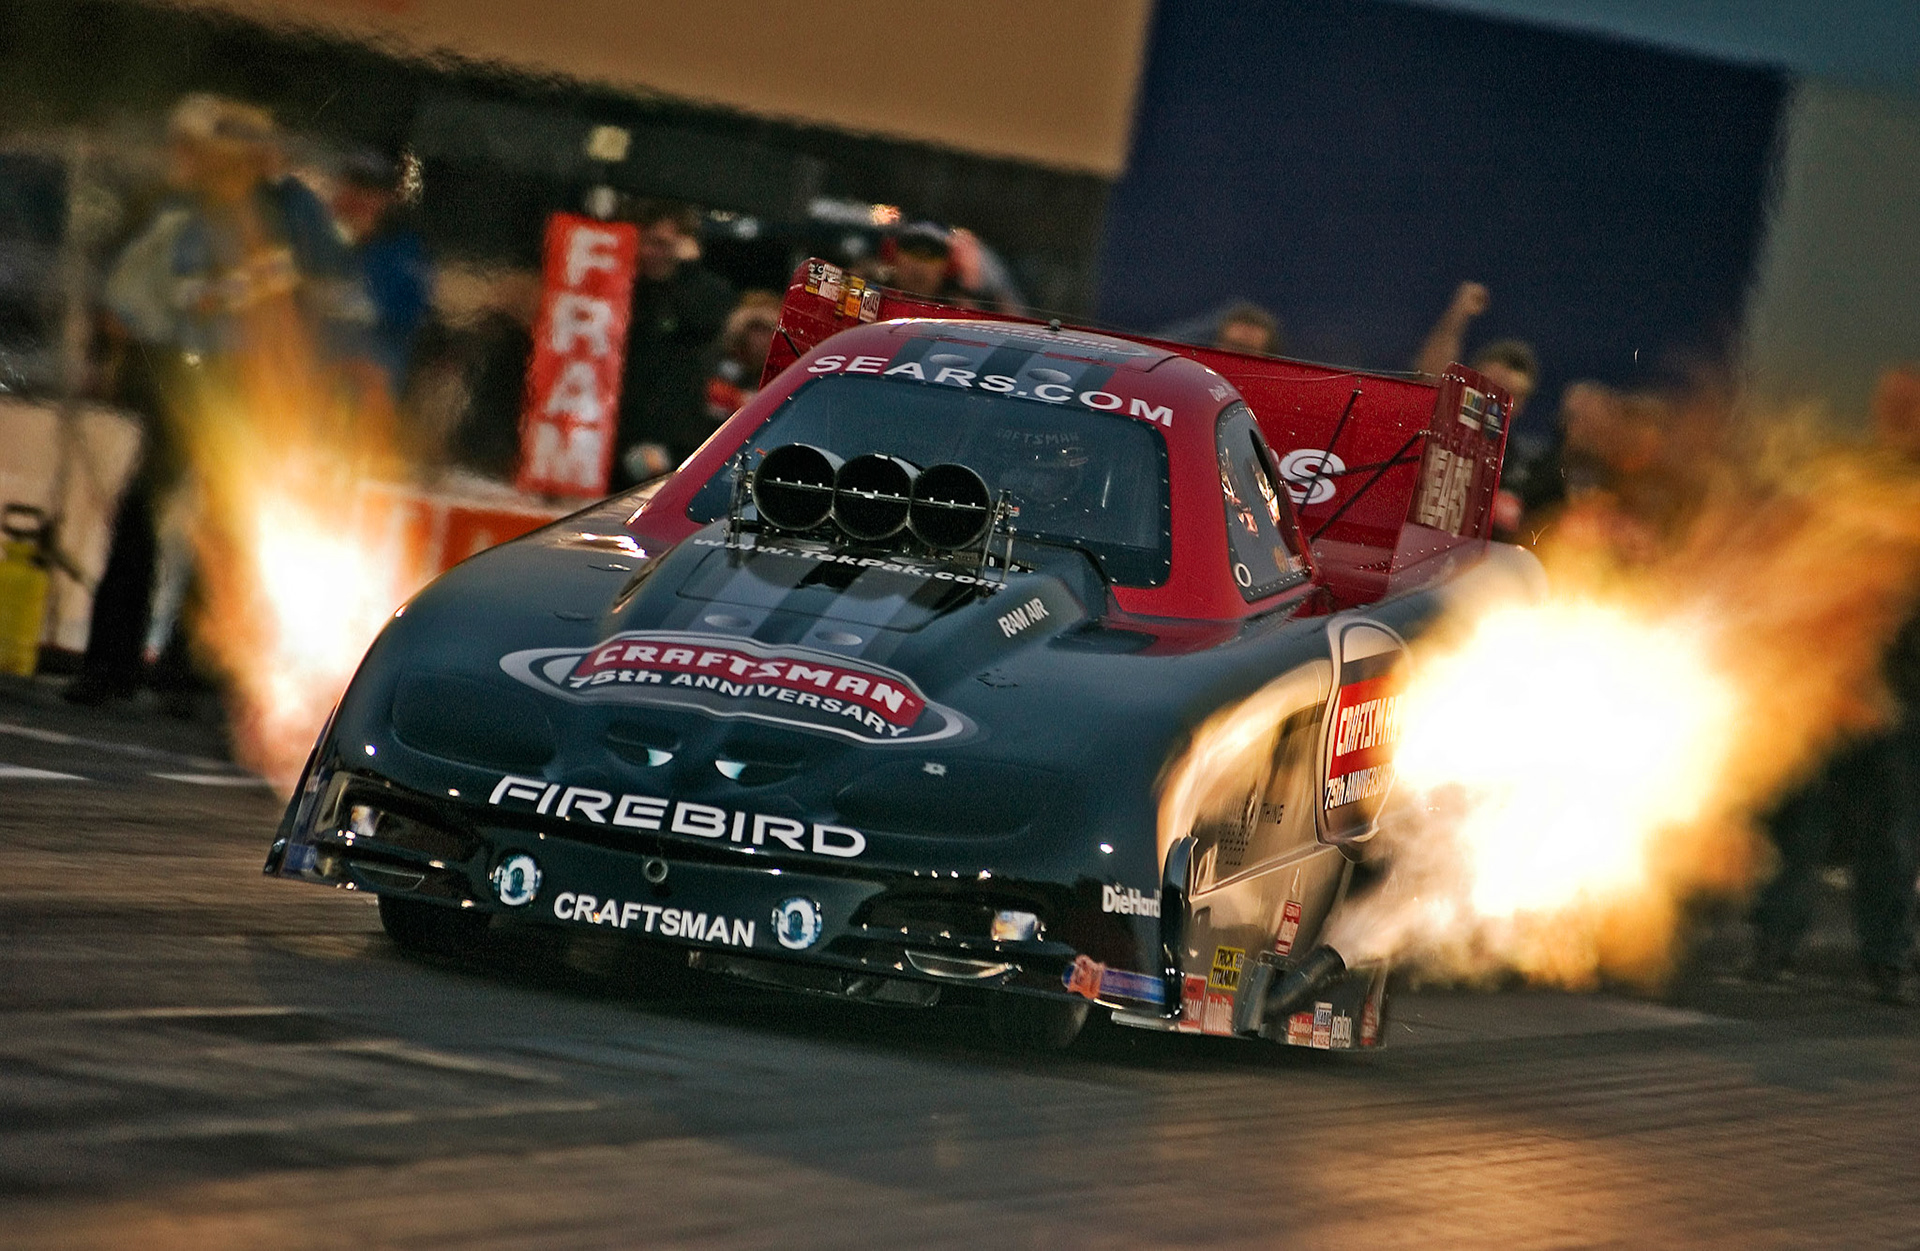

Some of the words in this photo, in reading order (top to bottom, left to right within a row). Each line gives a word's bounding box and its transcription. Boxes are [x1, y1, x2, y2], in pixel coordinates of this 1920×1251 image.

[528, 226, 618, 488] FRAM
[807, 354, 1174, 428] SEARS.COM
[998, 612, 1028, 638] RAM
[1024, 597, 1050, 624] AIR
[568, 669, 663, 690] 75th
[670, 672, 909, 738] ANNIVERSARY
[593, 644, 911, 714] CRAFTSMAN
[488, 775, 867, 858] FIREBIRD
[553, 891, 756, 948] CRAFTSMAN
[1102, 882, 1161, 919] DieHard
